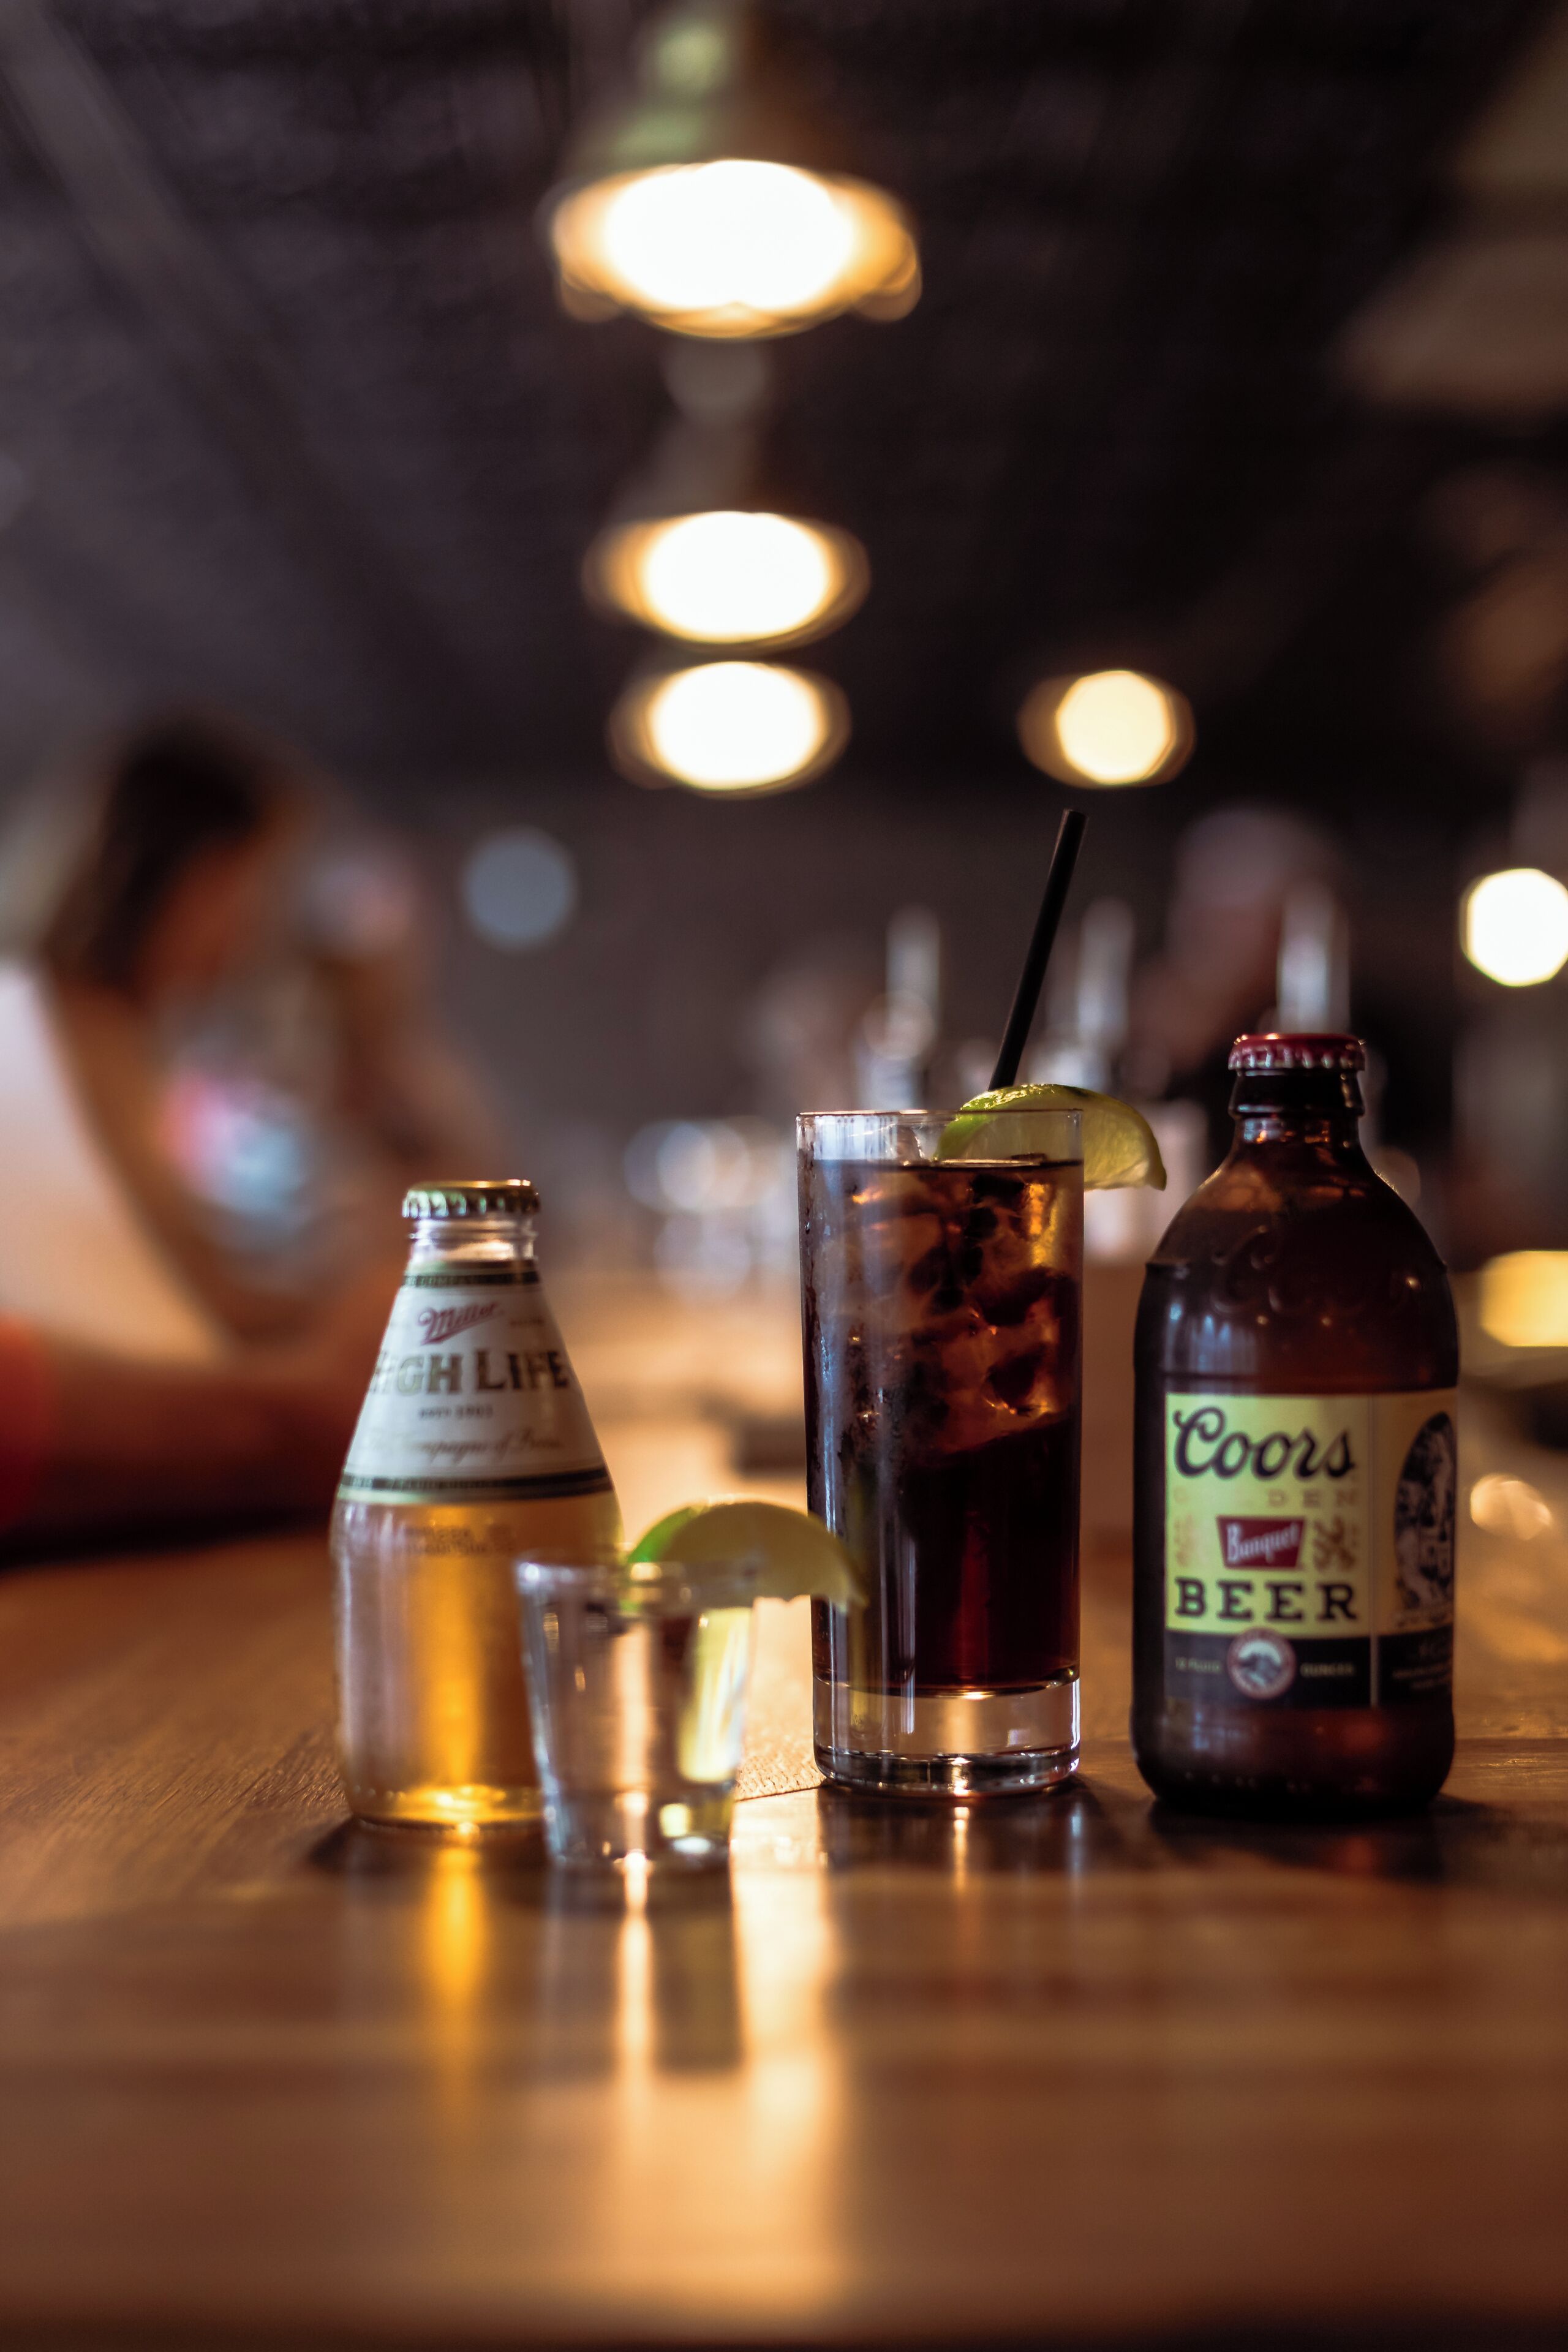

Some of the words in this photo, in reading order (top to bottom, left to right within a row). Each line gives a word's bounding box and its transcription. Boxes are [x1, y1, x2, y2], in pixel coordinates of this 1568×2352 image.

[418, 1302, 498, 1345] Miller
[475, 1351, 569, 1390] LIFE
[1173, 1407, 1356, 1481] Coors
[1226, 1523, 1300, 1563] Banquet
[1174, 1578, 1357, 1621] BEER
